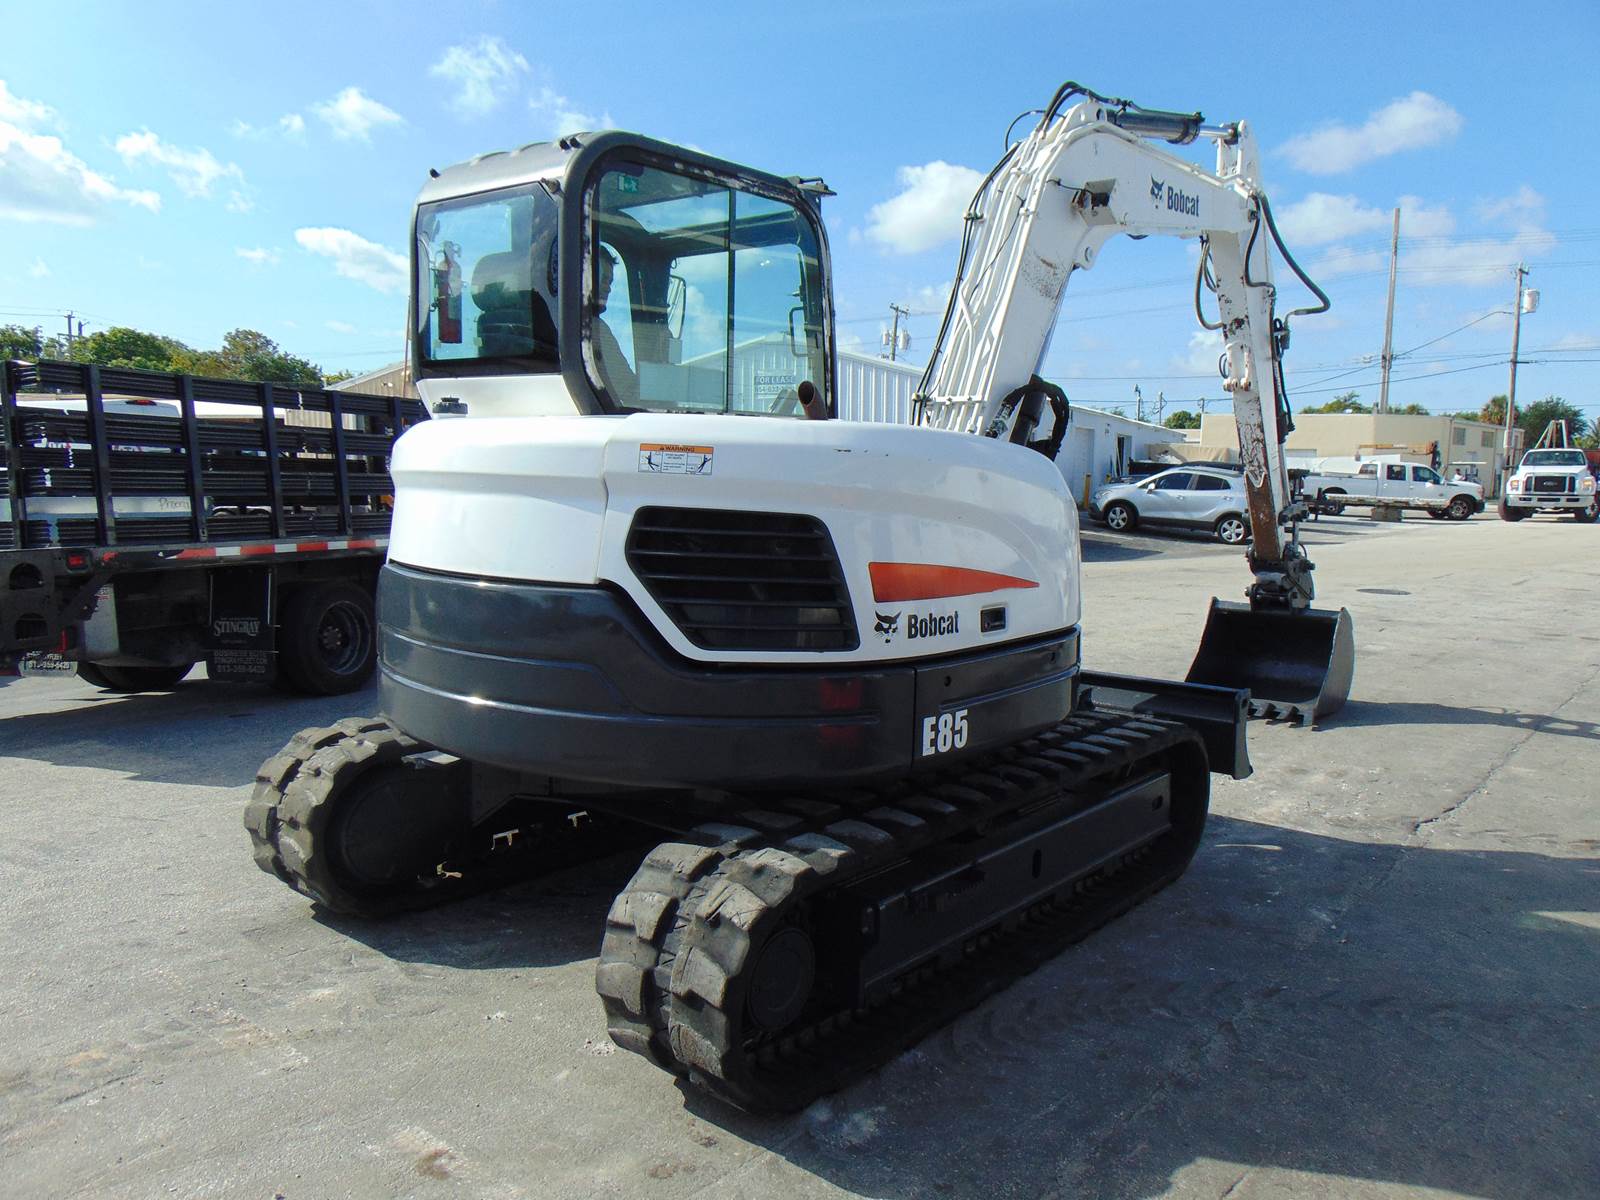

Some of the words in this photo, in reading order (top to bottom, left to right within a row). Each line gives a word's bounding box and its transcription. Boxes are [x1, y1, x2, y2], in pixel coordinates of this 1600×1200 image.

[1167, 185, 1199, 217] Bobcat
[665, 445, 695, 453] WARNING
[213, 620, 260, 636] STINGRAY
[907, 610, 959, 639] Bobcat
[922, 709, 969, 756] E85
